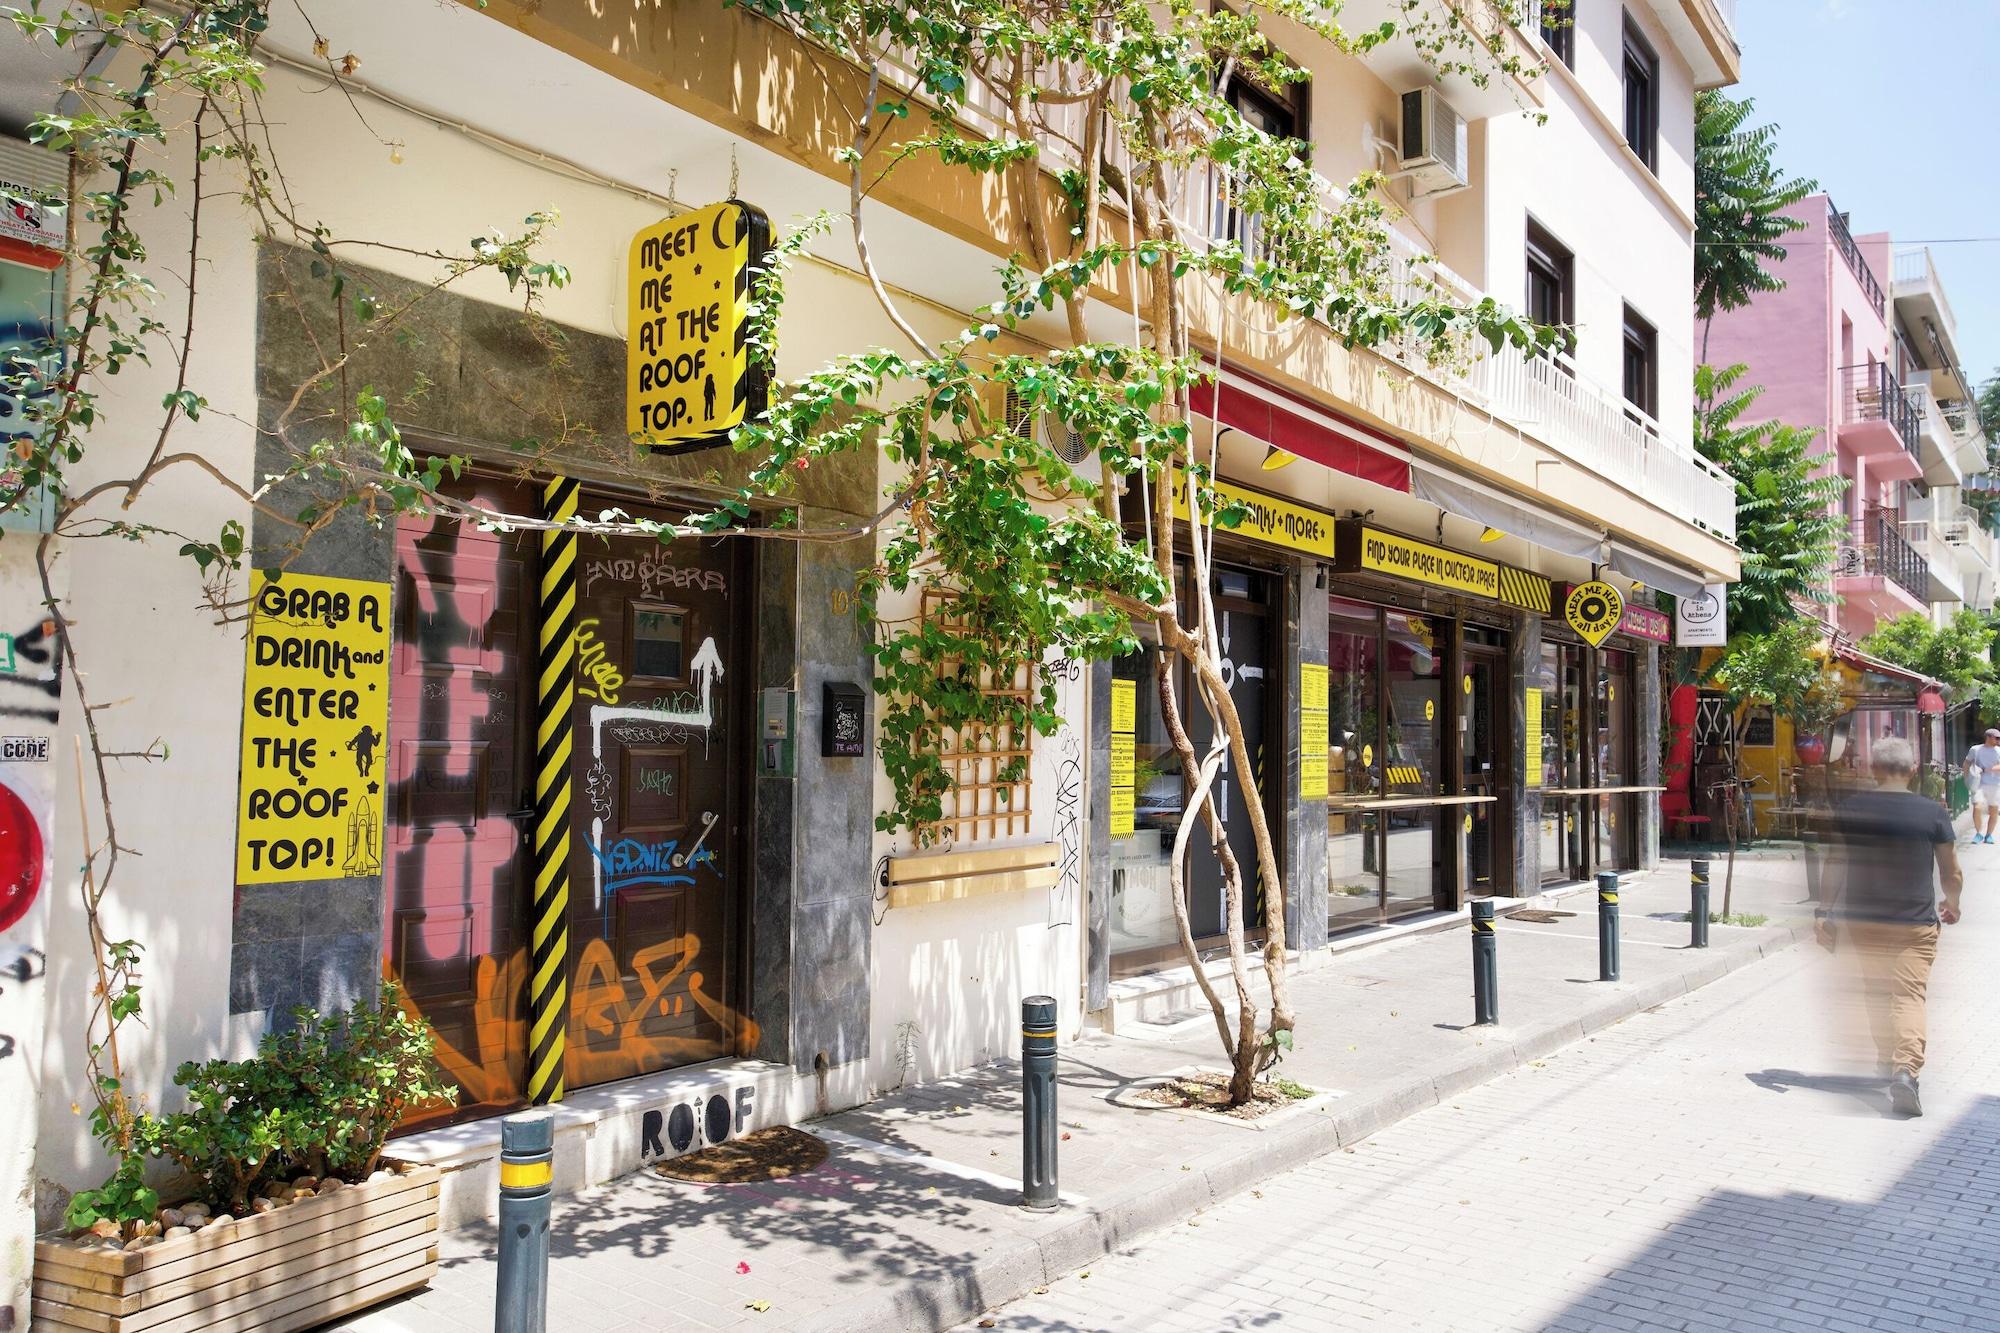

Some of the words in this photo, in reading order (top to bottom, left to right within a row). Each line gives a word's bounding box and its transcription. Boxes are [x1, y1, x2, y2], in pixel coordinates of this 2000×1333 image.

[641, 223, 699, 272] MEET
[640, 273, 672, 313] ME
[640, 317, 667, 356] AT
[676, 302, 719, 343] THE
[640, 349, 706, 393] ROOF
[640, 397, 693, 433] TOP.
[1285, 512, 1319, 541] MORE
[1367, 539, 1386, 565] FIND
[1388, 544, 1410, 568] YOUR
[1412, 551, 1435, 577] PLACE
[1437, 558, 1444, 581] IN
[1476, 568, 1496, 592] SPACE
[258, 585, 350, 629] GRAB
[359, 595, 383, 633] A
[831, 590, 849, 616] 10
[1569, 590, 1583, 620] MEET
[1585, 586, 1602, 595] ME
[1602, 590, 1619, 617] HERE
[1576, 622, 1590, 632] all
[1593, 618, 1612, 633] day
[255, 635, 356, 680] DRINK
[352, 649, 384, 665] and
[253, 686, 359, 727] ENTER
[252, 737, 317, 776] THE
[248, 787, 349, 820] ROOF
[247, 837, 334, 872] TOP!
[641, 1086, 755, 1159] ROOF
